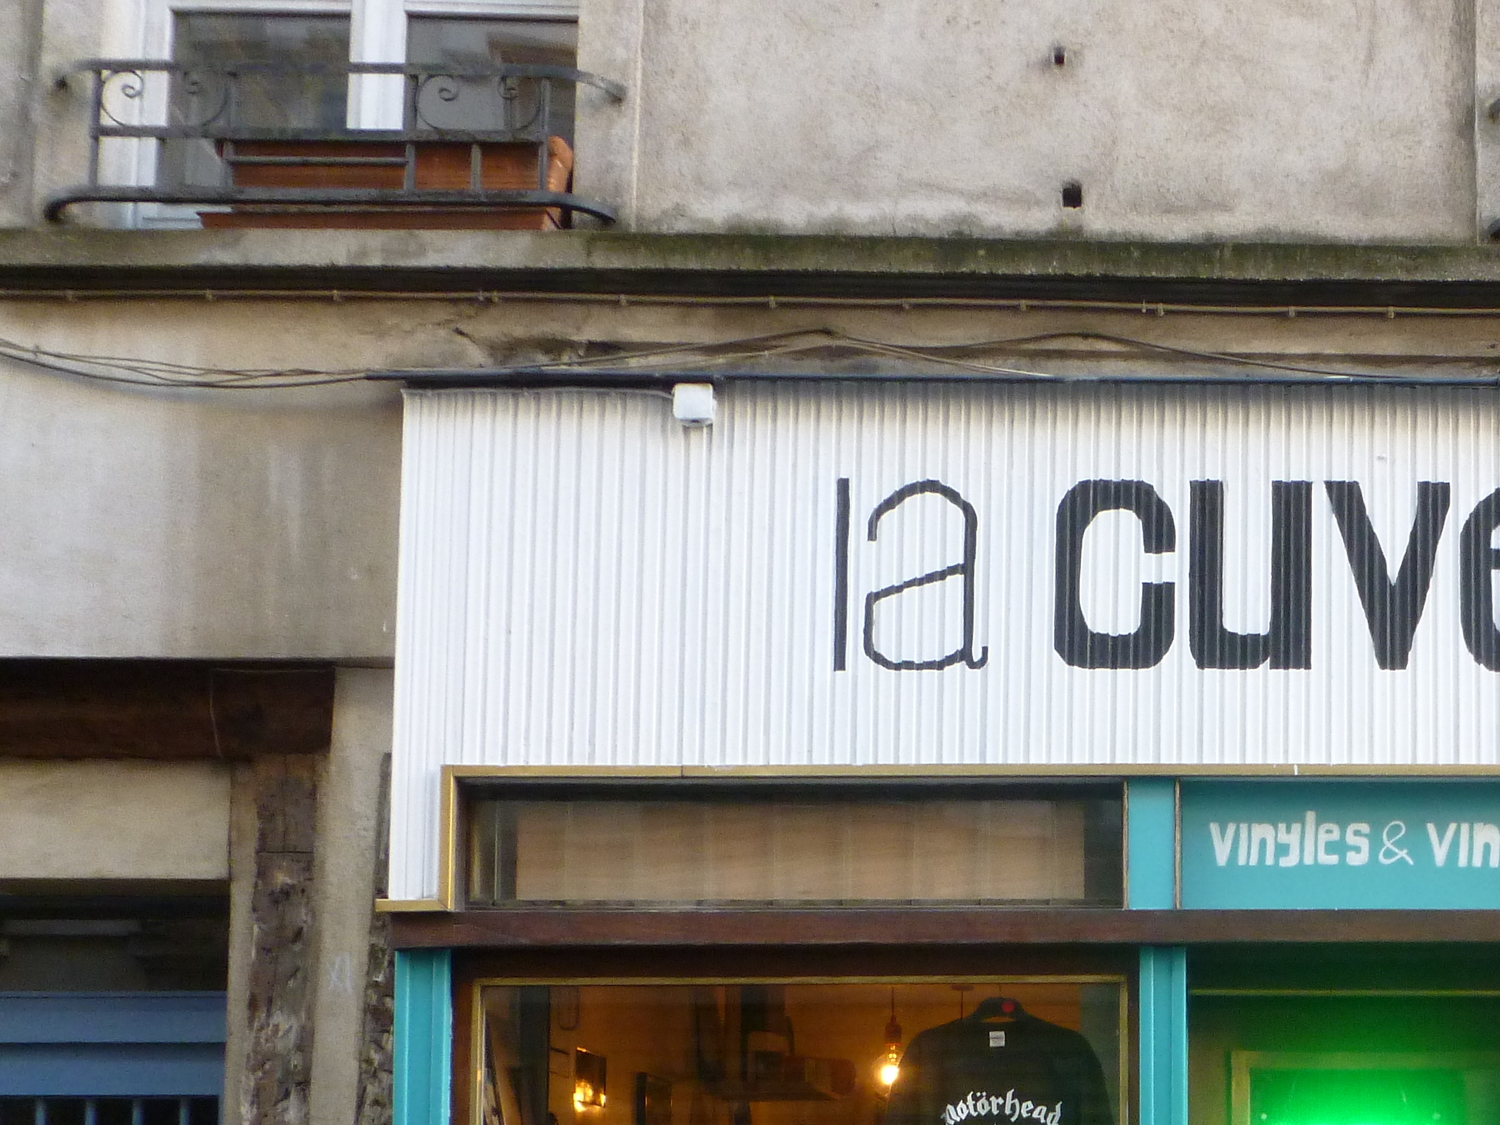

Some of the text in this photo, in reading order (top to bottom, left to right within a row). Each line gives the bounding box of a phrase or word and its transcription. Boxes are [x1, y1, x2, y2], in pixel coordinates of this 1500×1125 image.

[833, 477, 989, 672] la
[1210, 810, 1370, 867] vinyles
[1378, 820, 1414, 866] &
